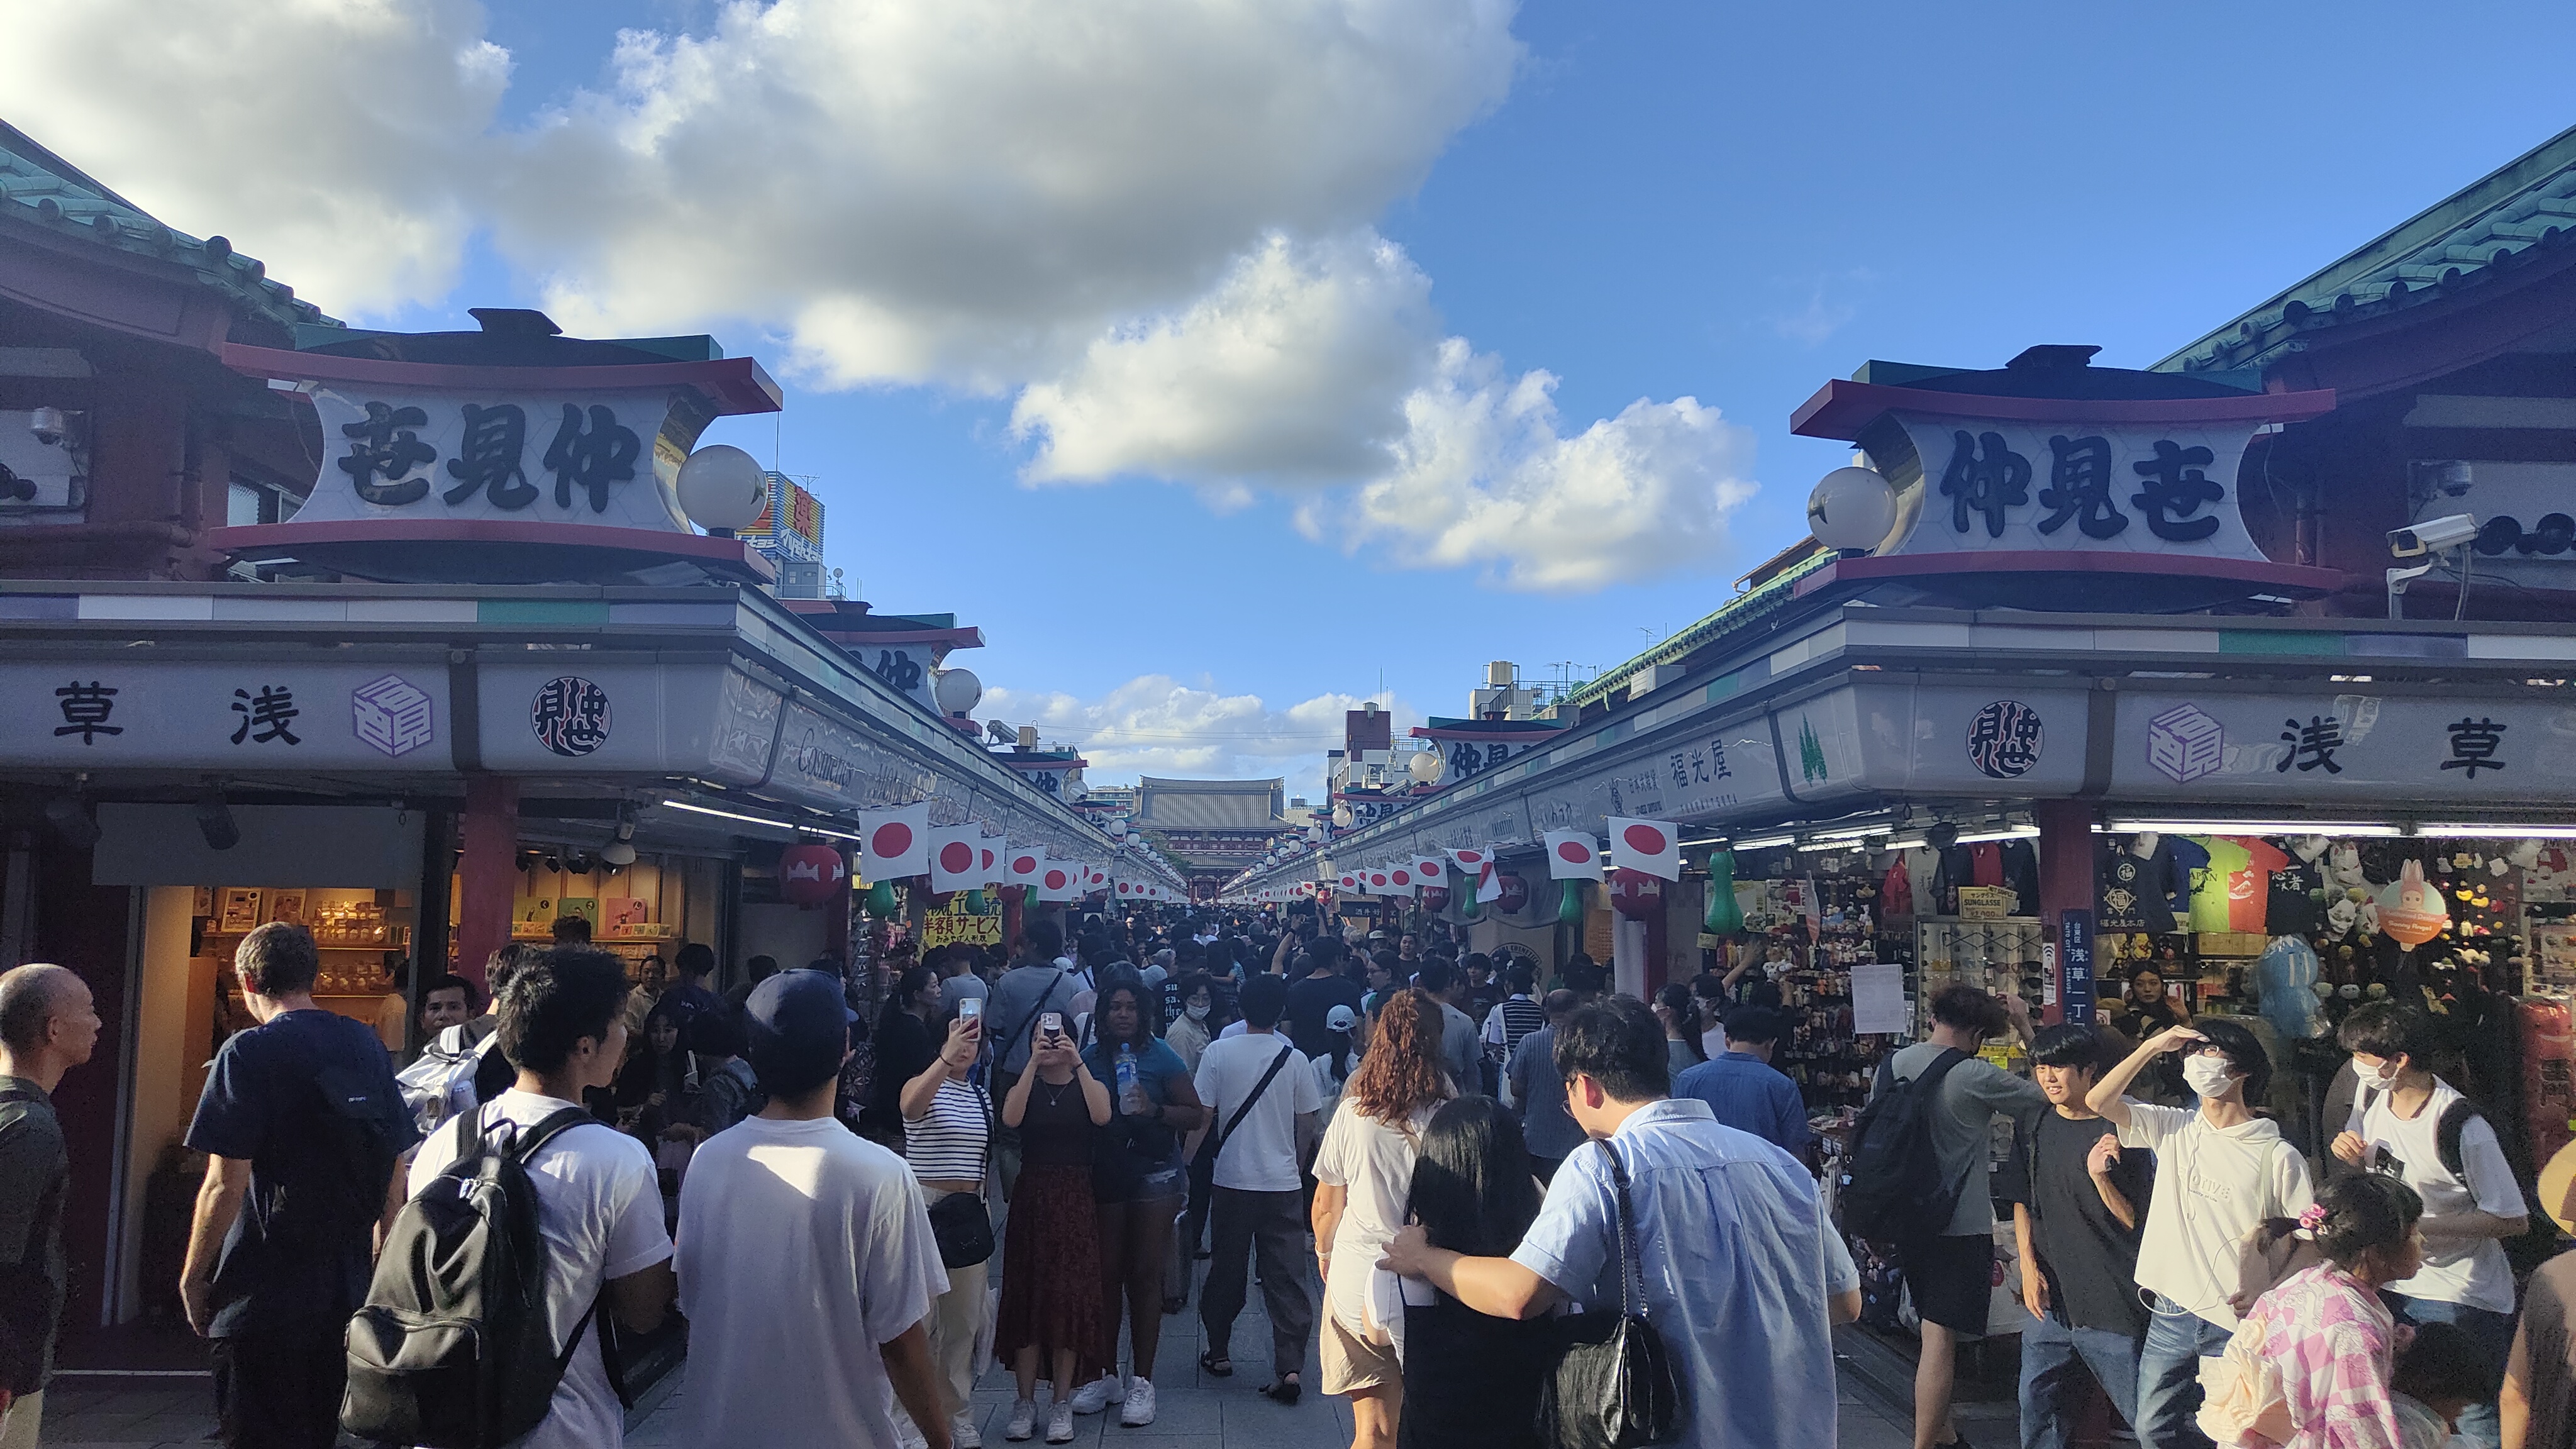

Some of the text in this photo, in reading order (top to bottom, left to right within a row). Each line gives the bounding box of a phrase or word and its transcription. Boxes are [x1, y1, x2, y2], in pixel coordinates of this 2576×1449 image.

[795, 486, 813, 536] 薬
[798, 728, 852, 787] Cosmetics
[1670, 739, 1731, 789] 福光屋
[2276, 716, 2507, 779] 浅草
[2190, 872, 2218, 882] APAN
[2112, 892, 2126, 906] 福
[924, 916, 1001, 936] 半額サービス
[2388, 920, 2433, 931] Sonny Angel
[2070, 948, 2086, 1026] 浅草一丁
[2189, 1189, 2204, 1197] uality
